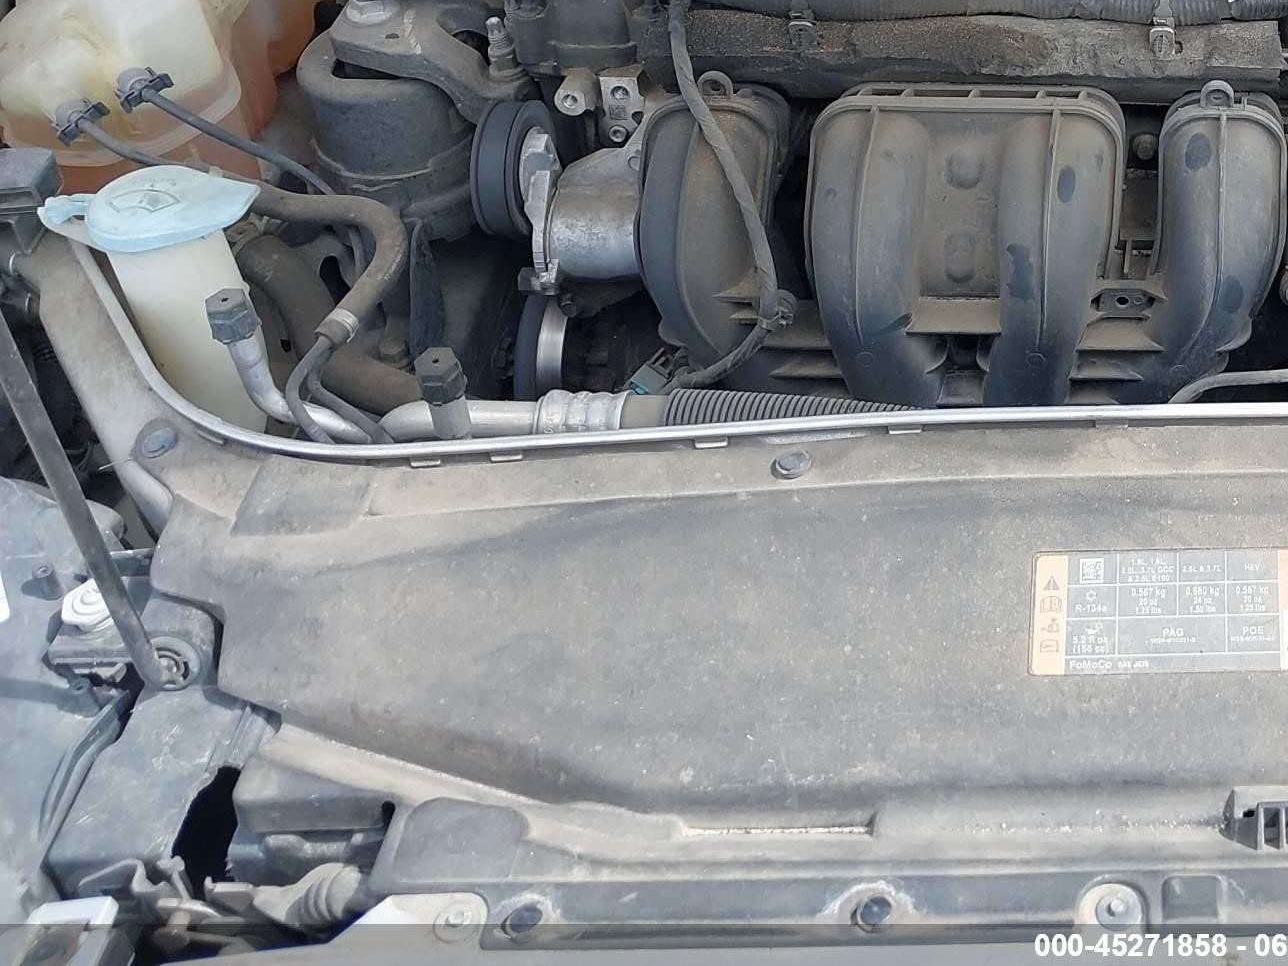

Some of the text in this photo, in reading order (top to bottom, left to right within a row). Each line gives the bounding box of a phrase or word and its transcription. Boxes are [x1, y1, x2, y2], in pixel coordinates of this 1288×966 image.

[1244, 562, 1261, 571] HEV
[1155, 587, 1166, 598] kg
[1209, 585, 1220, 597] kg
[1260, 585, 1269, 595] kg
[1075, 604, 1107, 613] R-134a
[1162, 627, 1184, 636] PAG
[1242, 625, 1264, 635] POE
[1069, 660, 1112, 669] FoMoCo
